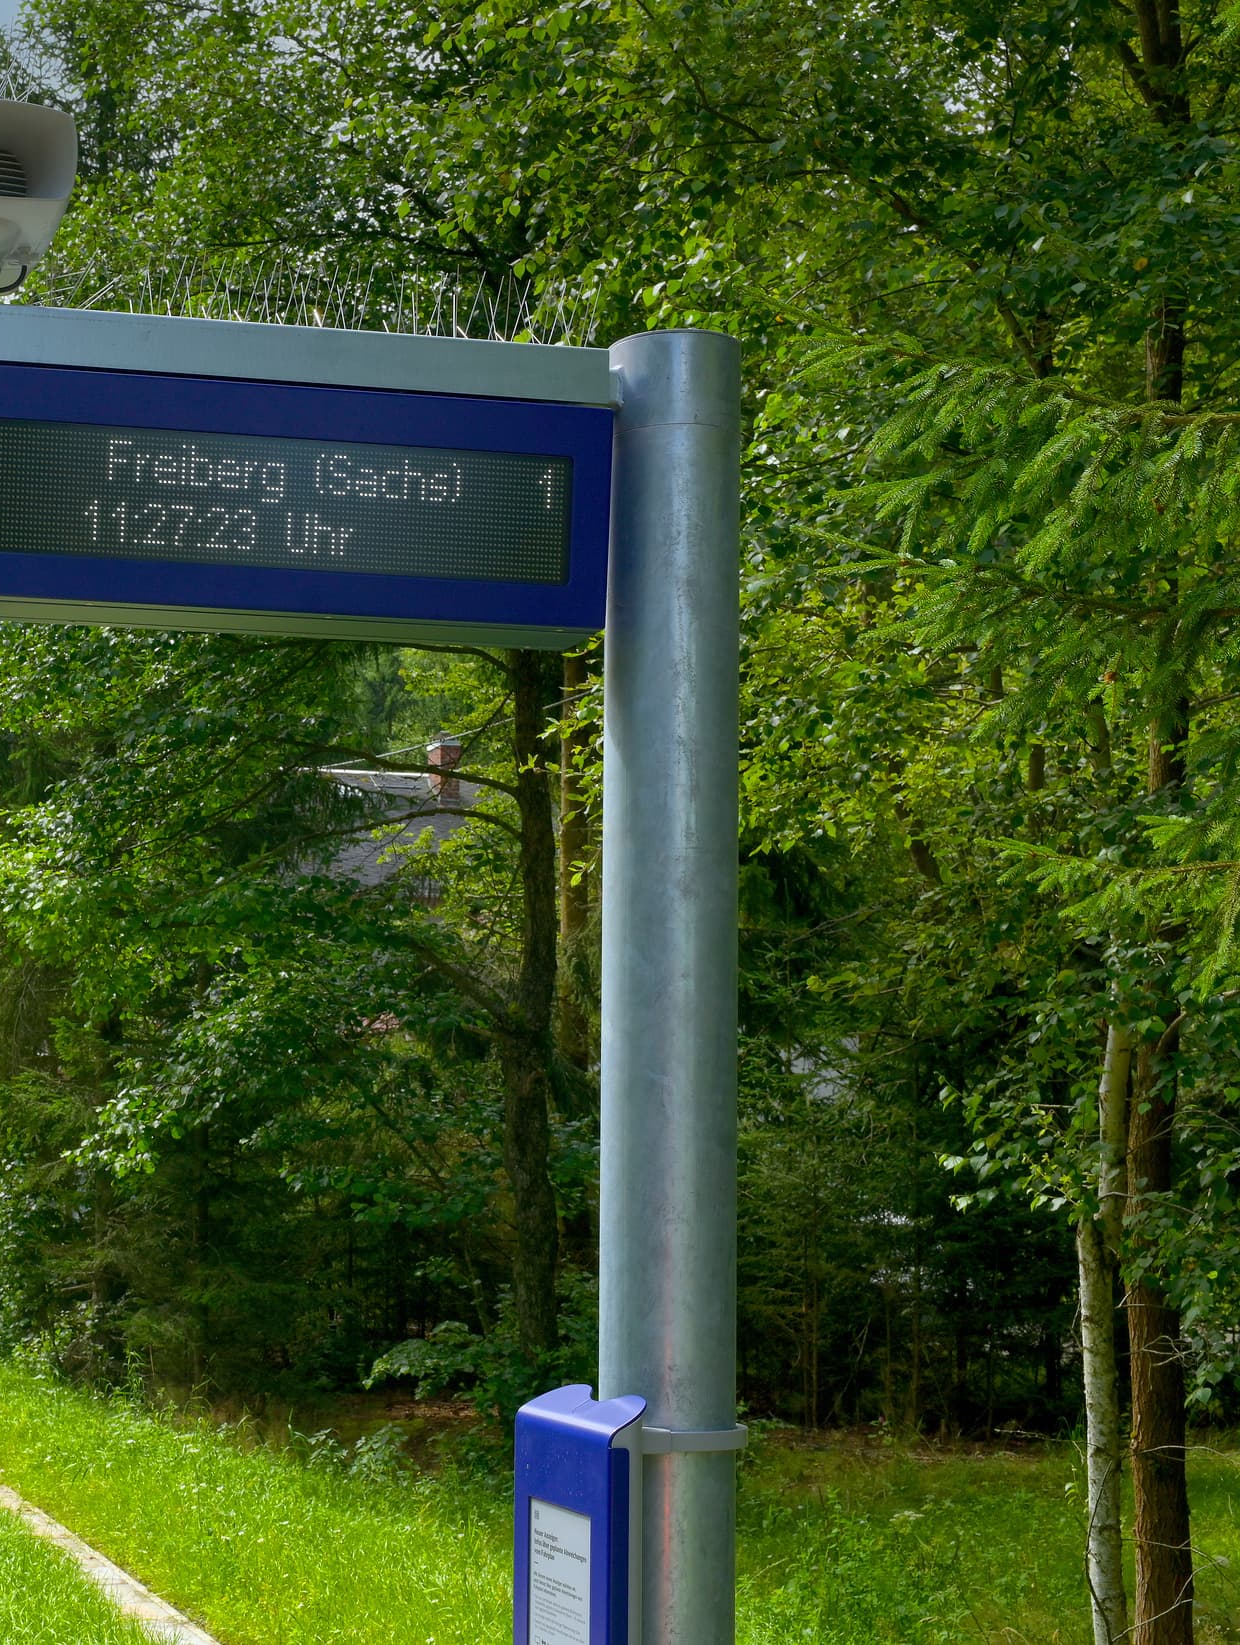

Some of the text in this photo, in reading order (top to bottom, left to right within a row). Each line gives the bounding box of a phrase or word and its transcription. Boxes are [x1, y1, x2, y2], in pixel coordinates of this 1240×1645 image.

[108, 440, 285, 503] Freiberg
[316, 453, 461, 503] (Sachs)
[539, 468, 552, 509] 1
[84, 499, 354, 555] 11:27:23 Uhr
